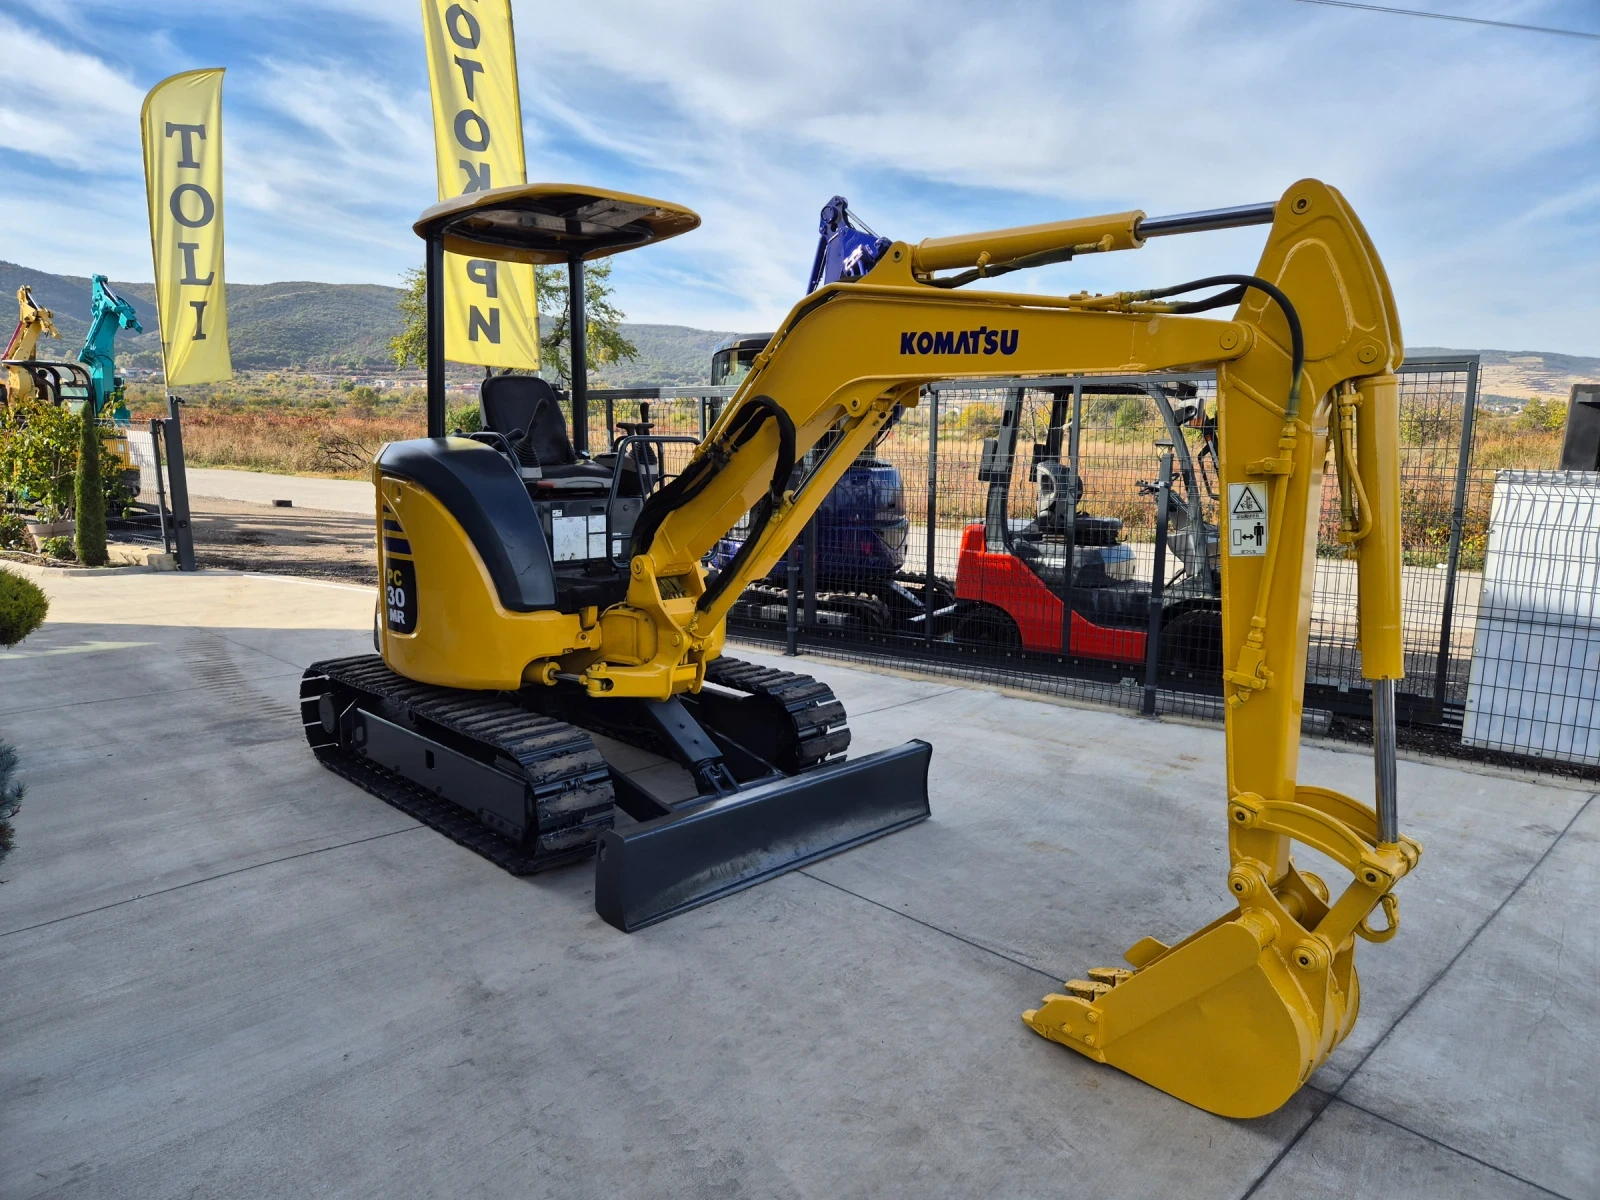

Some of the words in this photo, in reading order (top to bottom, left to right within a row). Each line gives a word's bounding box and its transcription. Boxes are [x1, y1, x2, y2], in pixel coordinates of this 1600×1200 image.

[165, 121, 215, 341] TOLI
[900, 326, 1019, 355] KOMATSU
[387, 568, 403, 586] PC
[387, 586, 406, 608] 30
[389, 608, 406, 625] MR
